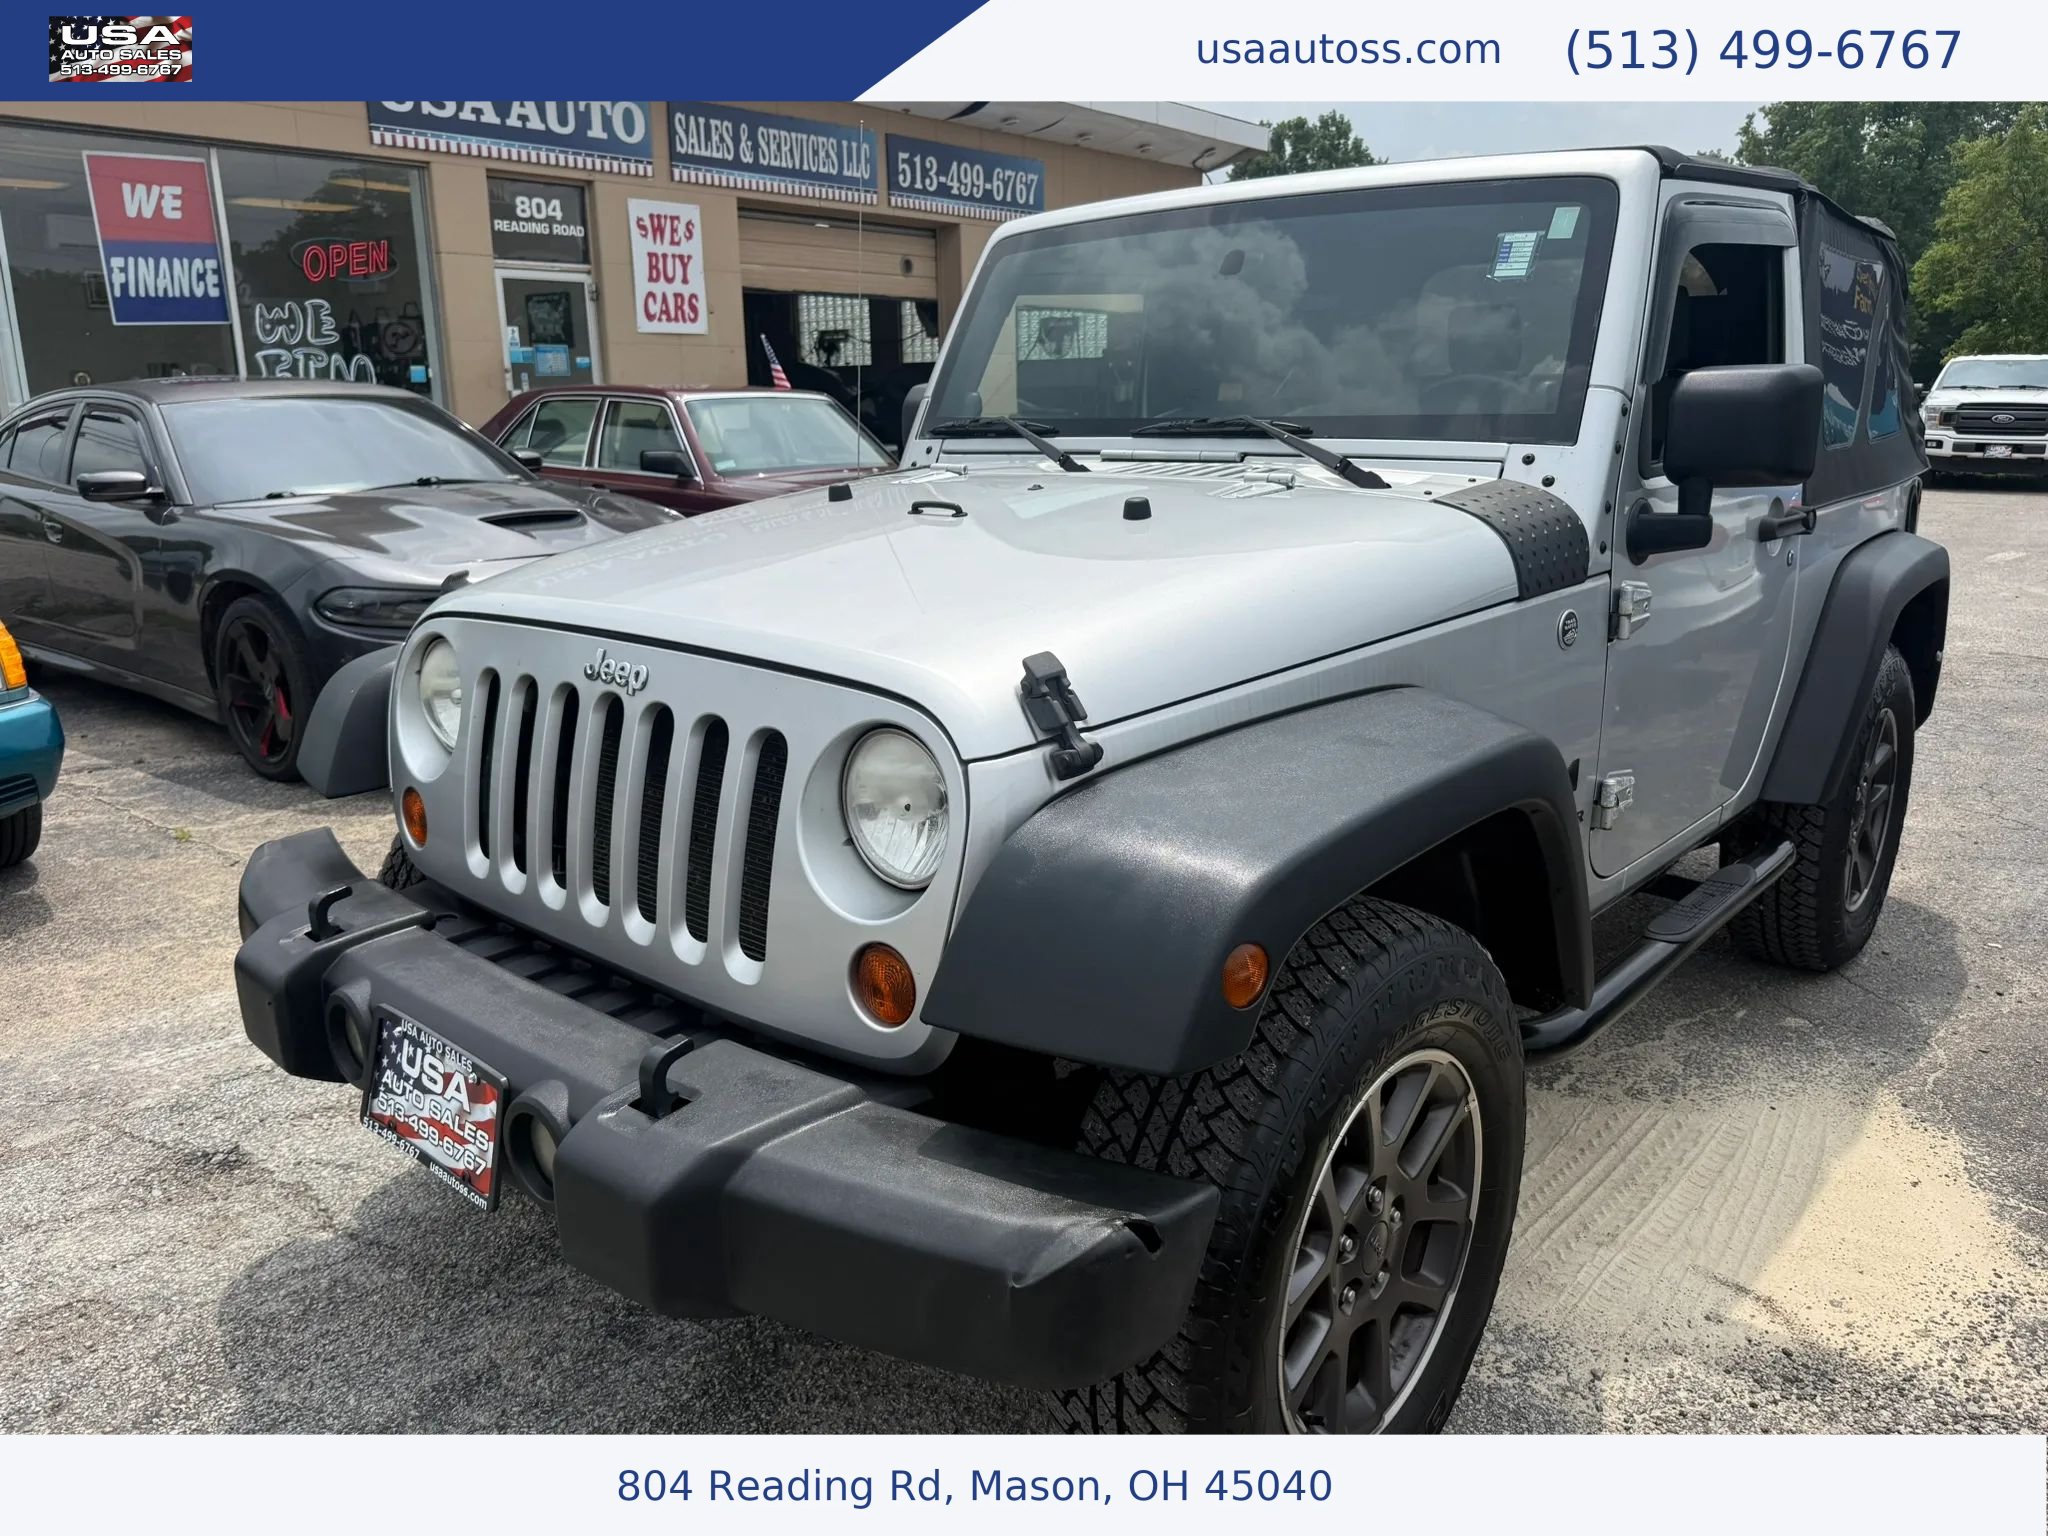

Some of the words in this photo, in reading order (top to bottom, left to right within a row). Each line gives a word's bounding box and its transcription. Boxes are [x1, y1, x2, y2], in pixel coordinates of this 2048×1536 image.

[505, 101, 646, 144] AUTO
[674, 112, 735, 161] SALES
[740, 123, 754, 164] &
[757, 126, 839, 176] SERVICES
[841, 139, 871, 180] LLC
[121, 182, 182, 219] WE
[898, 151, 1039, 205] 513-499-6767
[494, 219, 550, 235] READING
[552, 223, 585, 238] ROAD
[515, 196, 563, 221] 804
[110, 256, 220, 298] FINANCE
[303, 240, 388, 282] OPEN
[647, 251, 693, 285] BUY
[255, 299, 340, 345] WE
[643, 291, 699, 324] CARS
[584, 647, 649, 696] Jeep
[401, 1019, 418, 1040] USA
[420, 1032, 443, 1052] AUTO
[445, 1045, 473, 1073] SALES
[401, 1038, 471, 1114] USA
[382, 1068, 425, 1111] AUTO
[429, 1103, 489, 1152] SALES
[363, 1116, 420, 1160] 513-499-6767
[377, 1091, 487, 1177] 513-499-6767
[429, 1161, 488, 1211] usaautoss.com
